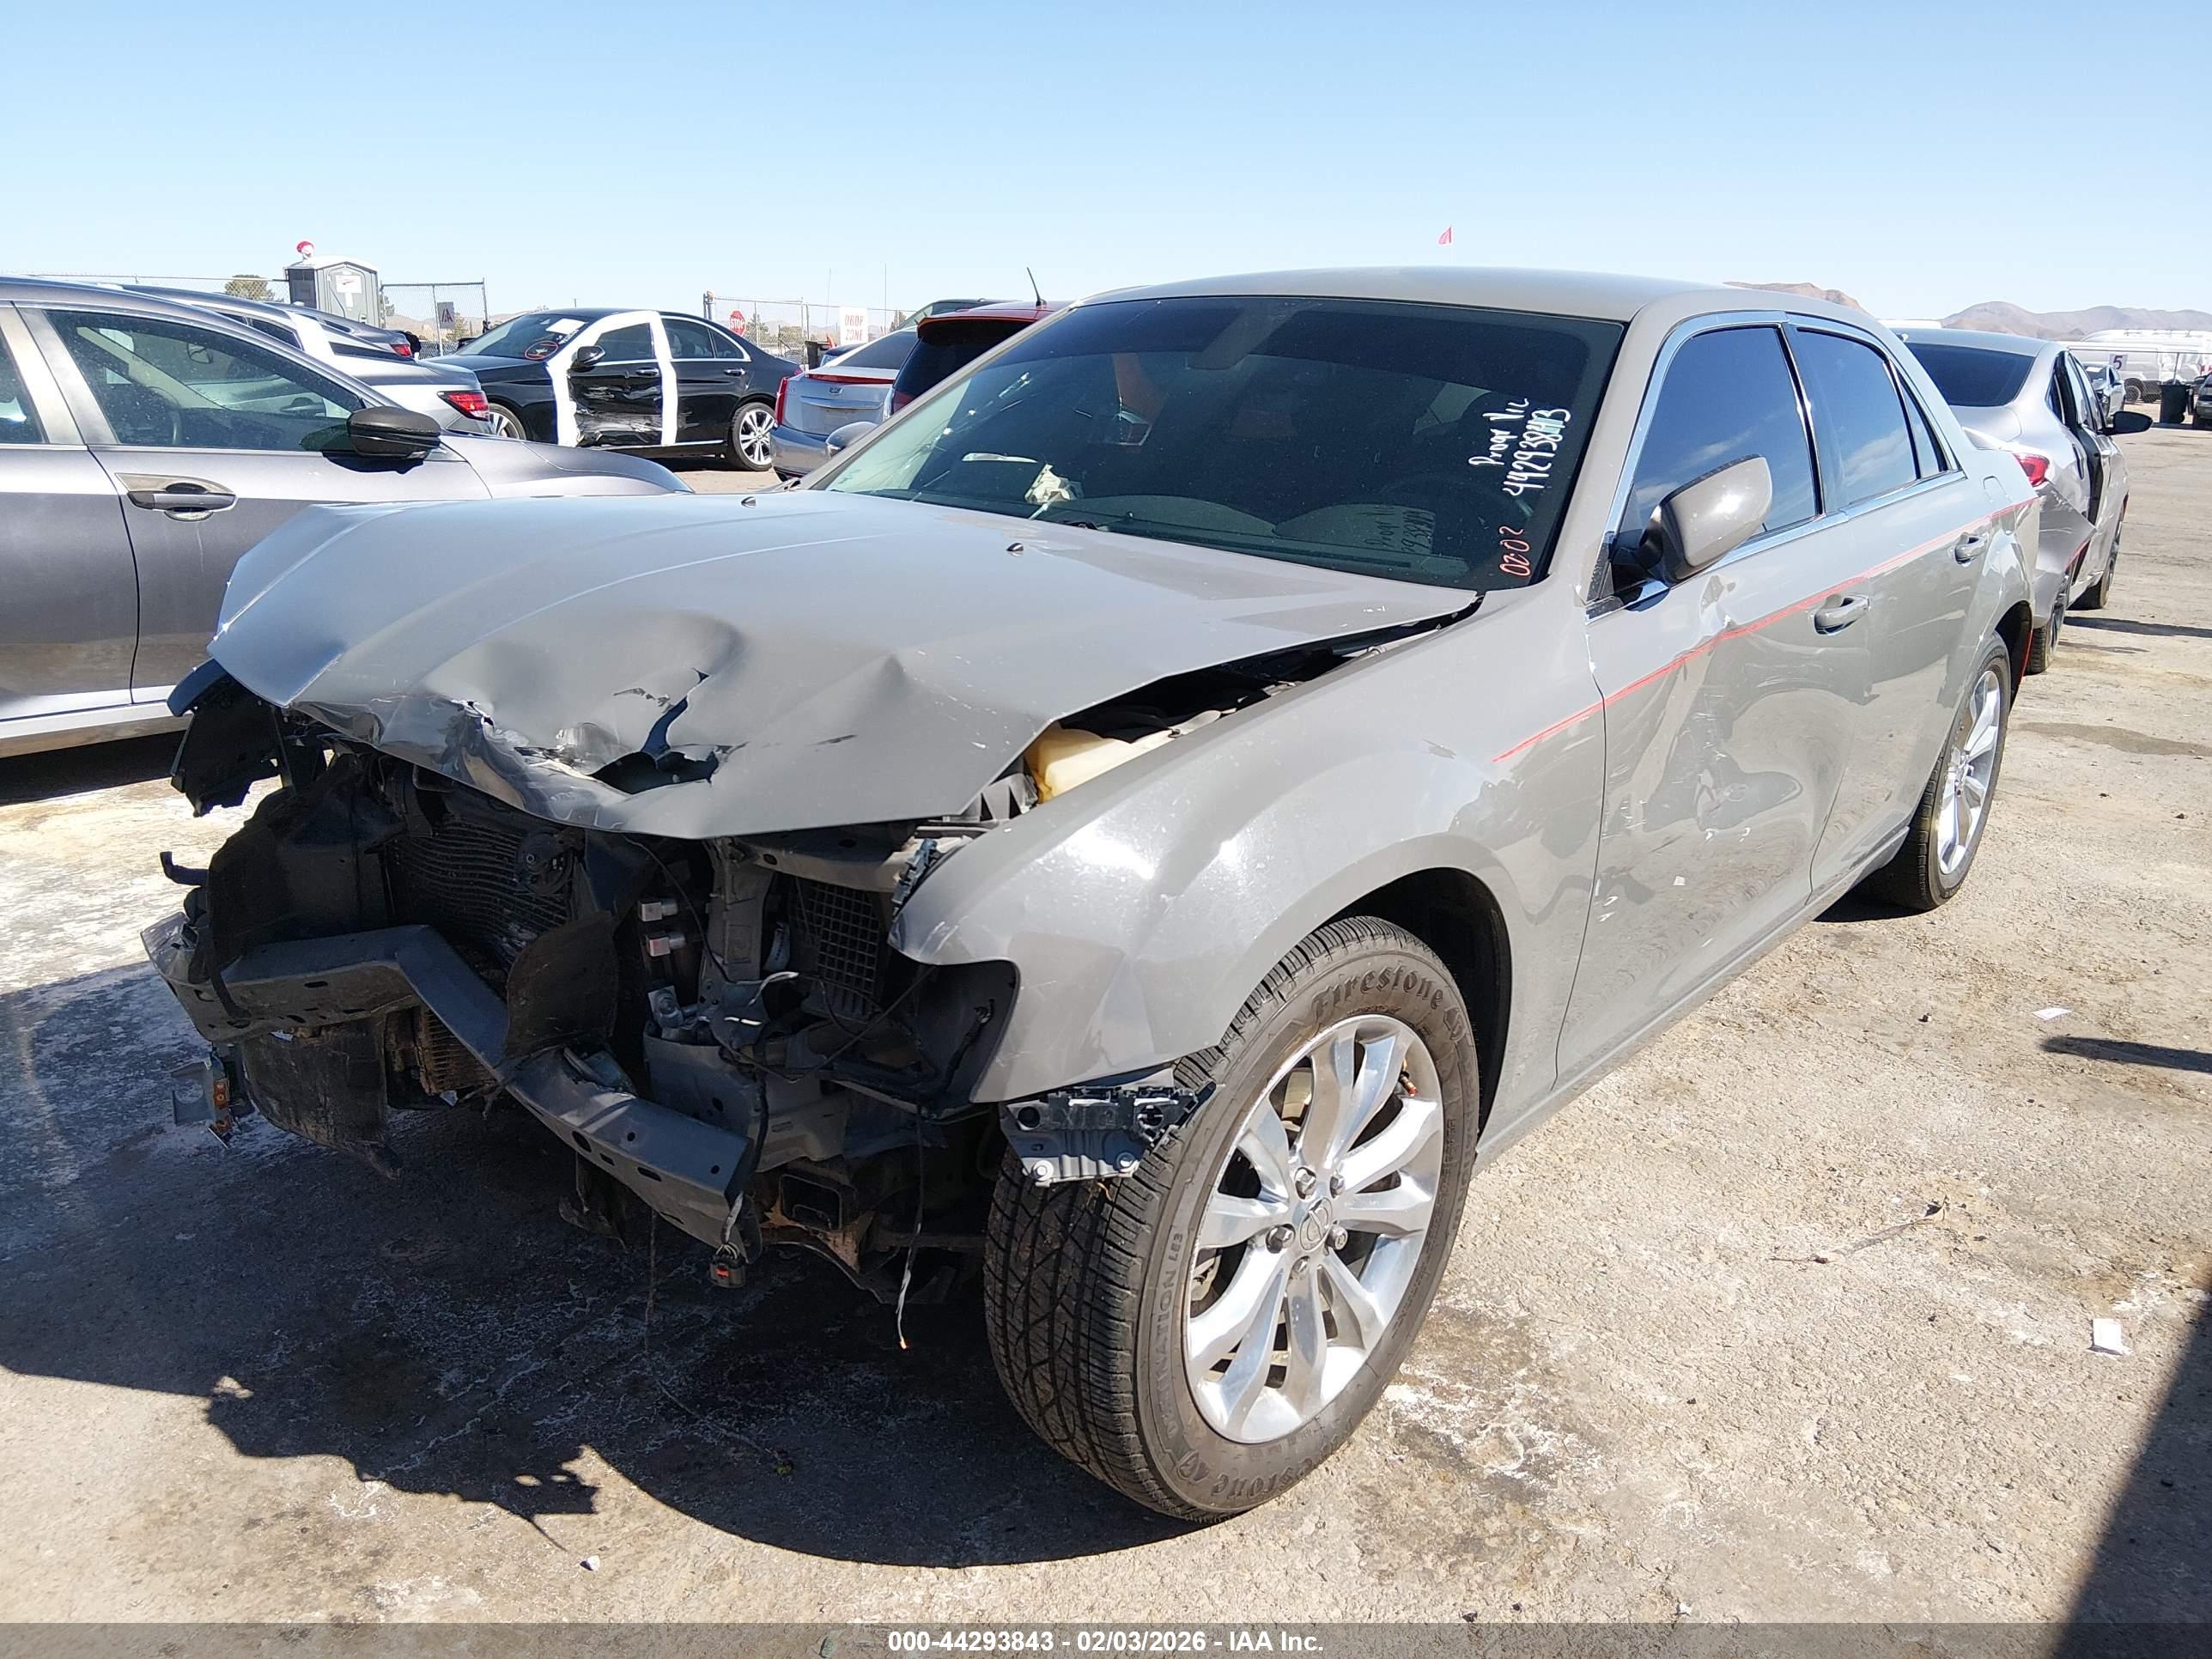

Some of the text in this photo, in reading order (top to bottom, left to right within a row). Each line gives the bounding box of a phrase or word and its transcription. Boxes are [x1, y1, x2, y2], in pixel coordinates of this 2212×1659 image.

[730, 318, 744, 330] STOP
[845, 314, 863, 326] DROP
[2112, 355, 2124, 370] 5
[1502, 408, 1571, 496] 44293843
[1311, 961, 1443, 1022] Firestone
[1169, 1232, 1183, 1263] LE3
